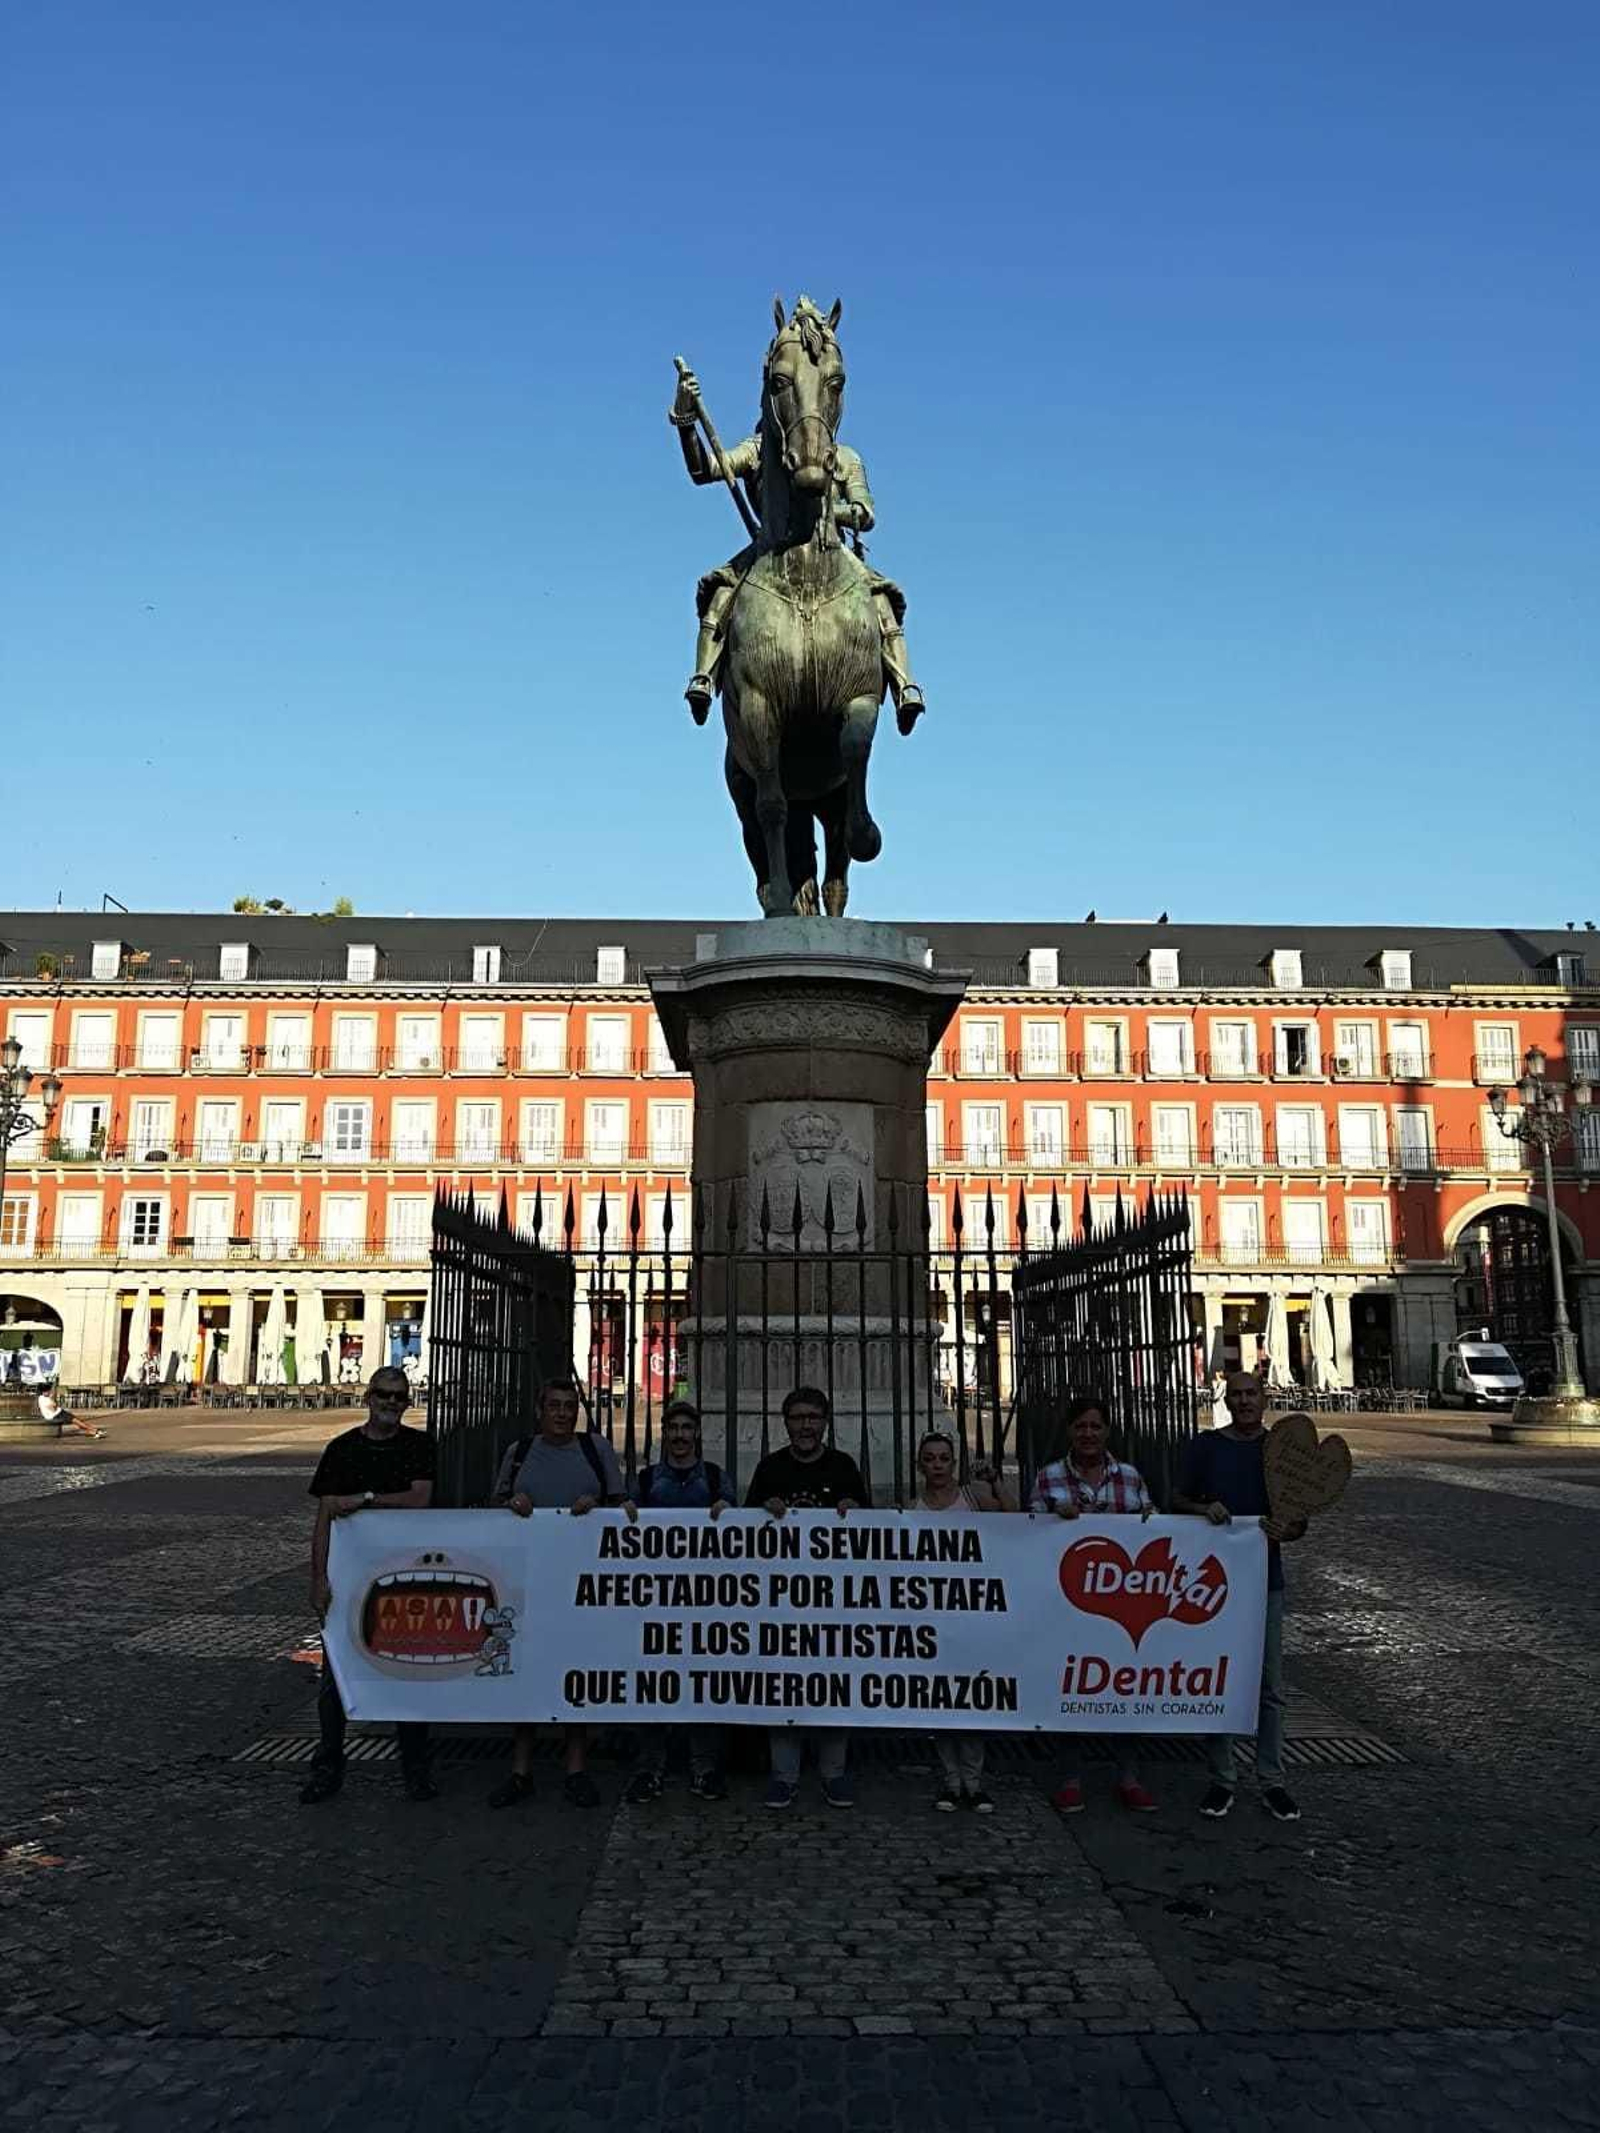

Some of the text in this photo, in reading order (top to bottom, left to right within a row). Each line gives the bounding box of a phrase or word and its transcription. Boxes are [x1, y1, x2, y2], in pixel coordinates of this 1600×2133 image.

[599, 1520, 983, 1563] ASOCIACIÓN SEVILLANA
[575, 1574, 1008, 1613] AFECTADOS POR LA ESTAFA
[643, 1621, 938, 1660] DE LOS DENTISTAS
[564, 1669, 1018, 1711] QUE NO TUVIERON CORAZÓN
[1062, 1655, 1229, 1697] iDental
[1060, 1699, 1225, 1715] DENTISTAS SIN CORAZÓN
